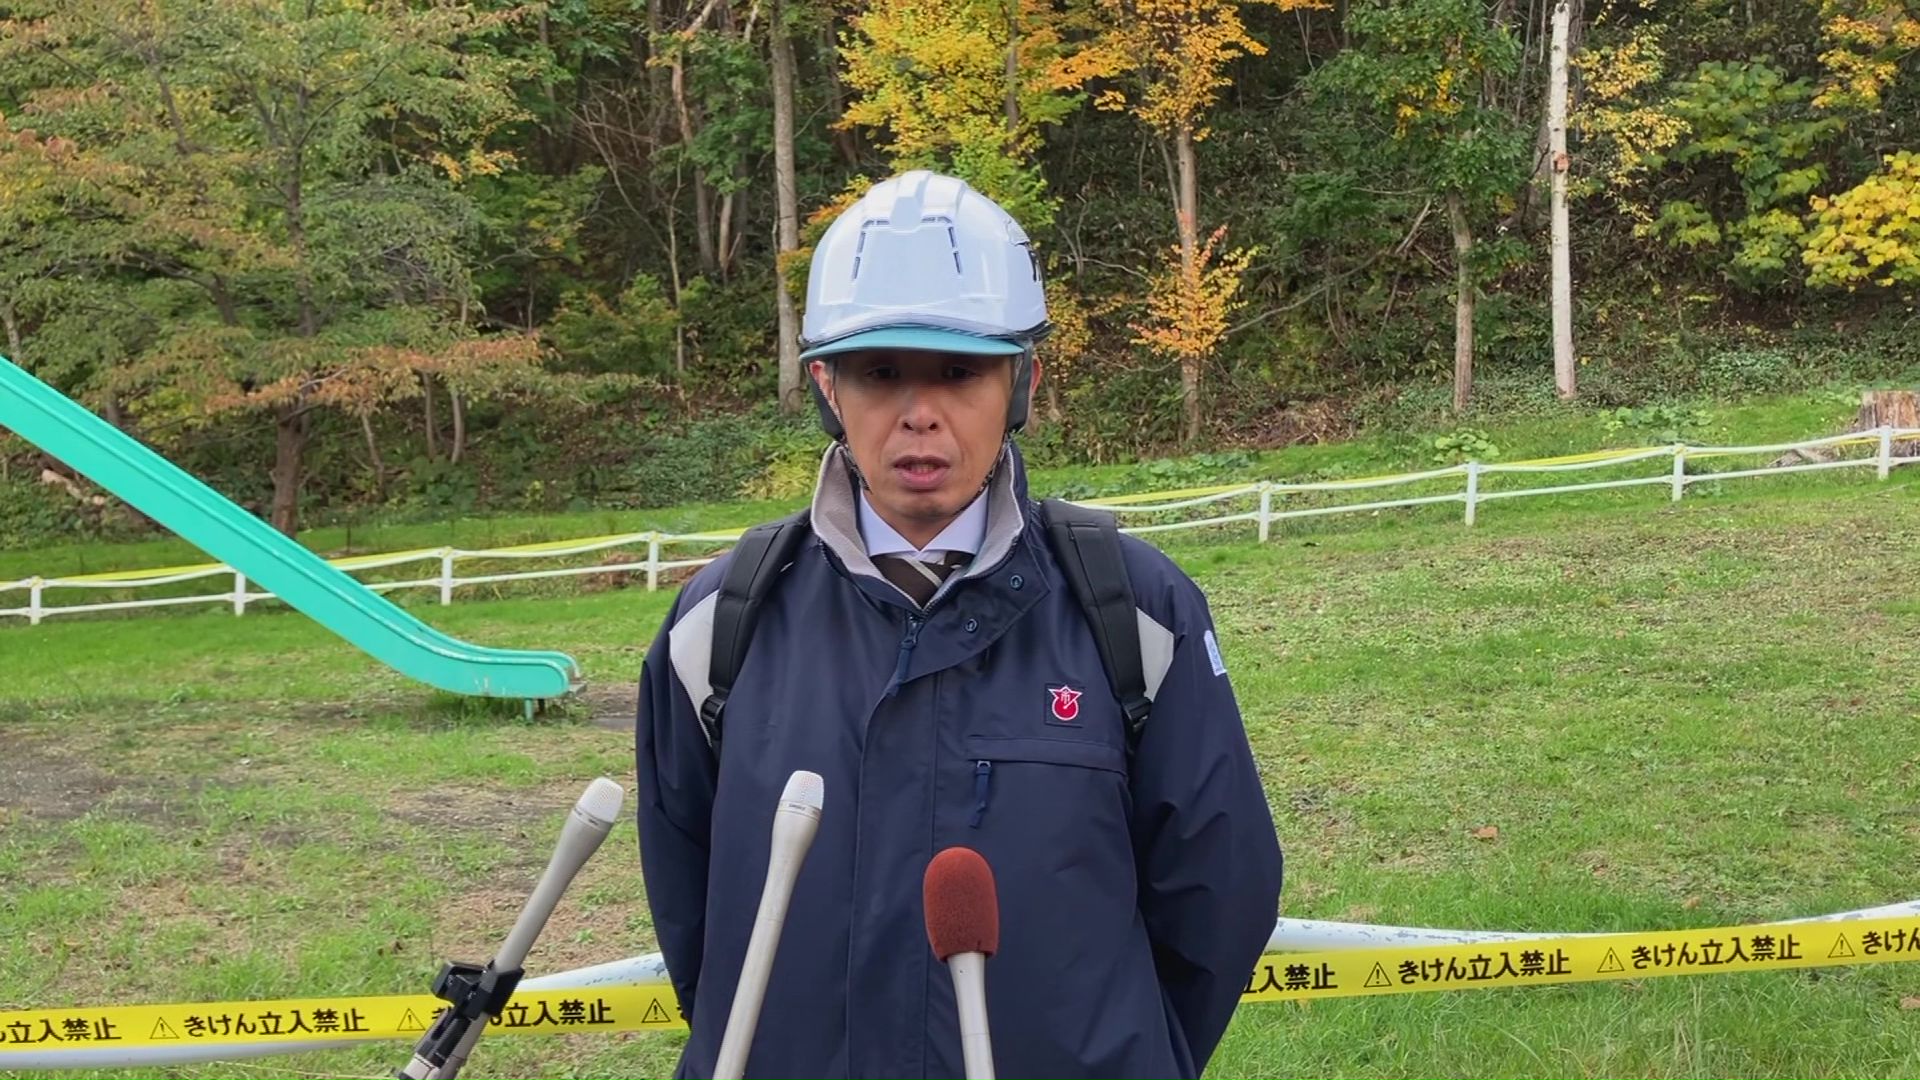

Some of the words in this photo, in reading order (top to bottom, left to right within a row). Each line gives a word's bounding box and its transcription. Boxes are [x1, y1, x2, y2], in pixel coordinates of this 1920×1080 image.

[1398, 949, 1572, 984] きけん立入禁止
[1632, 934, 1803, 969] きけん立入禁止
[184, 1008, 370, 1037] きけん立入禁止
